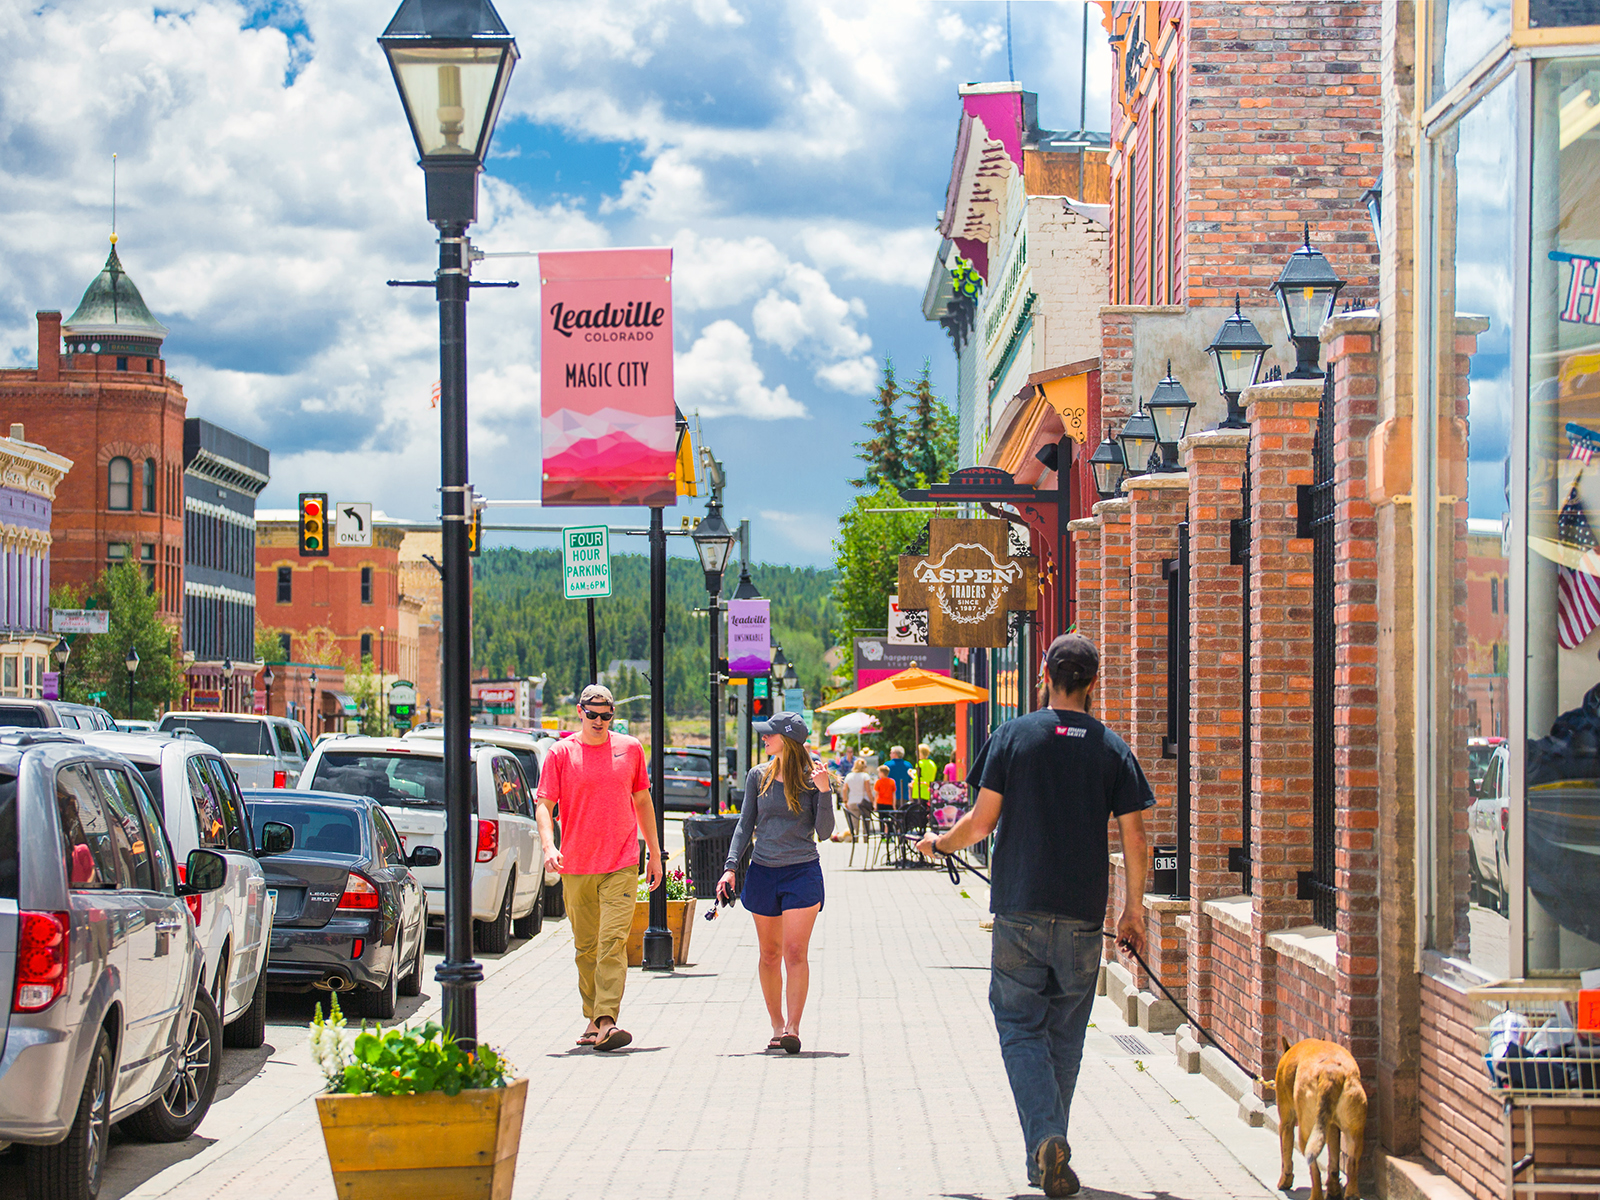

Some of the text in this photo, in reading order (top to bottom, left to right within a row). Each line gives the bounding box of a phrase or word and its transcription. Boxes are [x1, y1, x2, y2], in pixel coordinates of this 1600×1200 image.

[550, 301, 665, 338] Leadville
[584, 331, 654, 342] COLORADO
[566, 361, 649, 388] MAGIC CITY
[340, 533, 366, 542] ONLY
[571, 532, 602, 546] FOUR
[572, 549, 600, 561] HOUR
[566, 564, 608, 578] PARKING
[918, 568, 1016, 584] ASPEN
[951, 585, 986, 599] TRADERS
[731, 615, 767, 627] Leadville
[1156, 858, 1176, 869] 615
